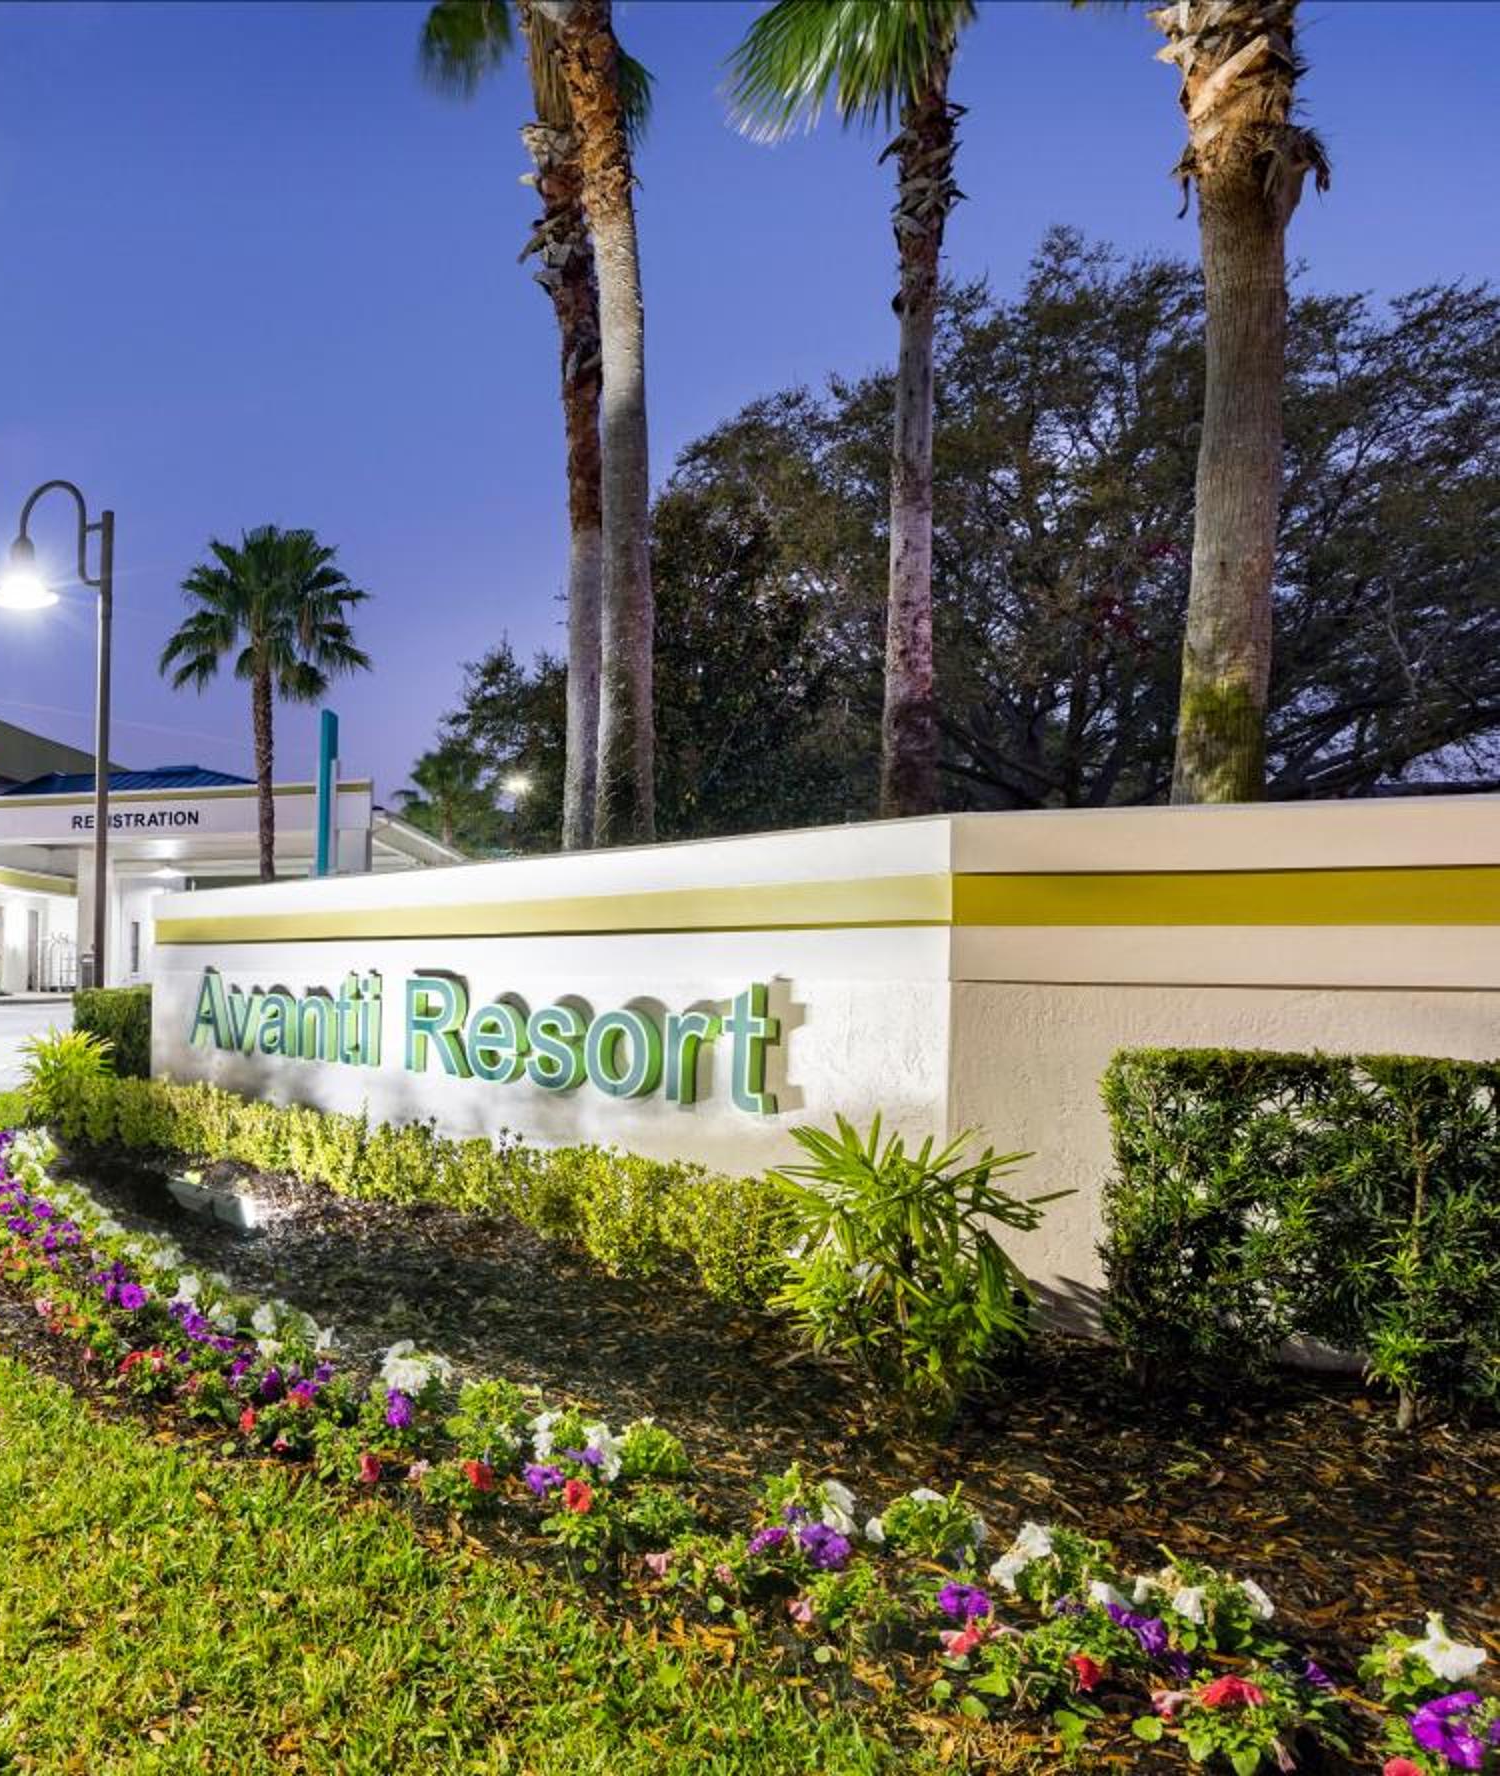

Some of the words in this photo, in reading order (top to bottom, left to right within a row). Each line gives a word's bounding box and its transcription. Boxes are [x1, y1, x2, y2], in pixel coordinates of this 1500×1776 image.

[71, 810, 199, 829] REISTRATION
[190, 969, 381, 1066] Avanti
[404, 971, 779, 1115] Resort
